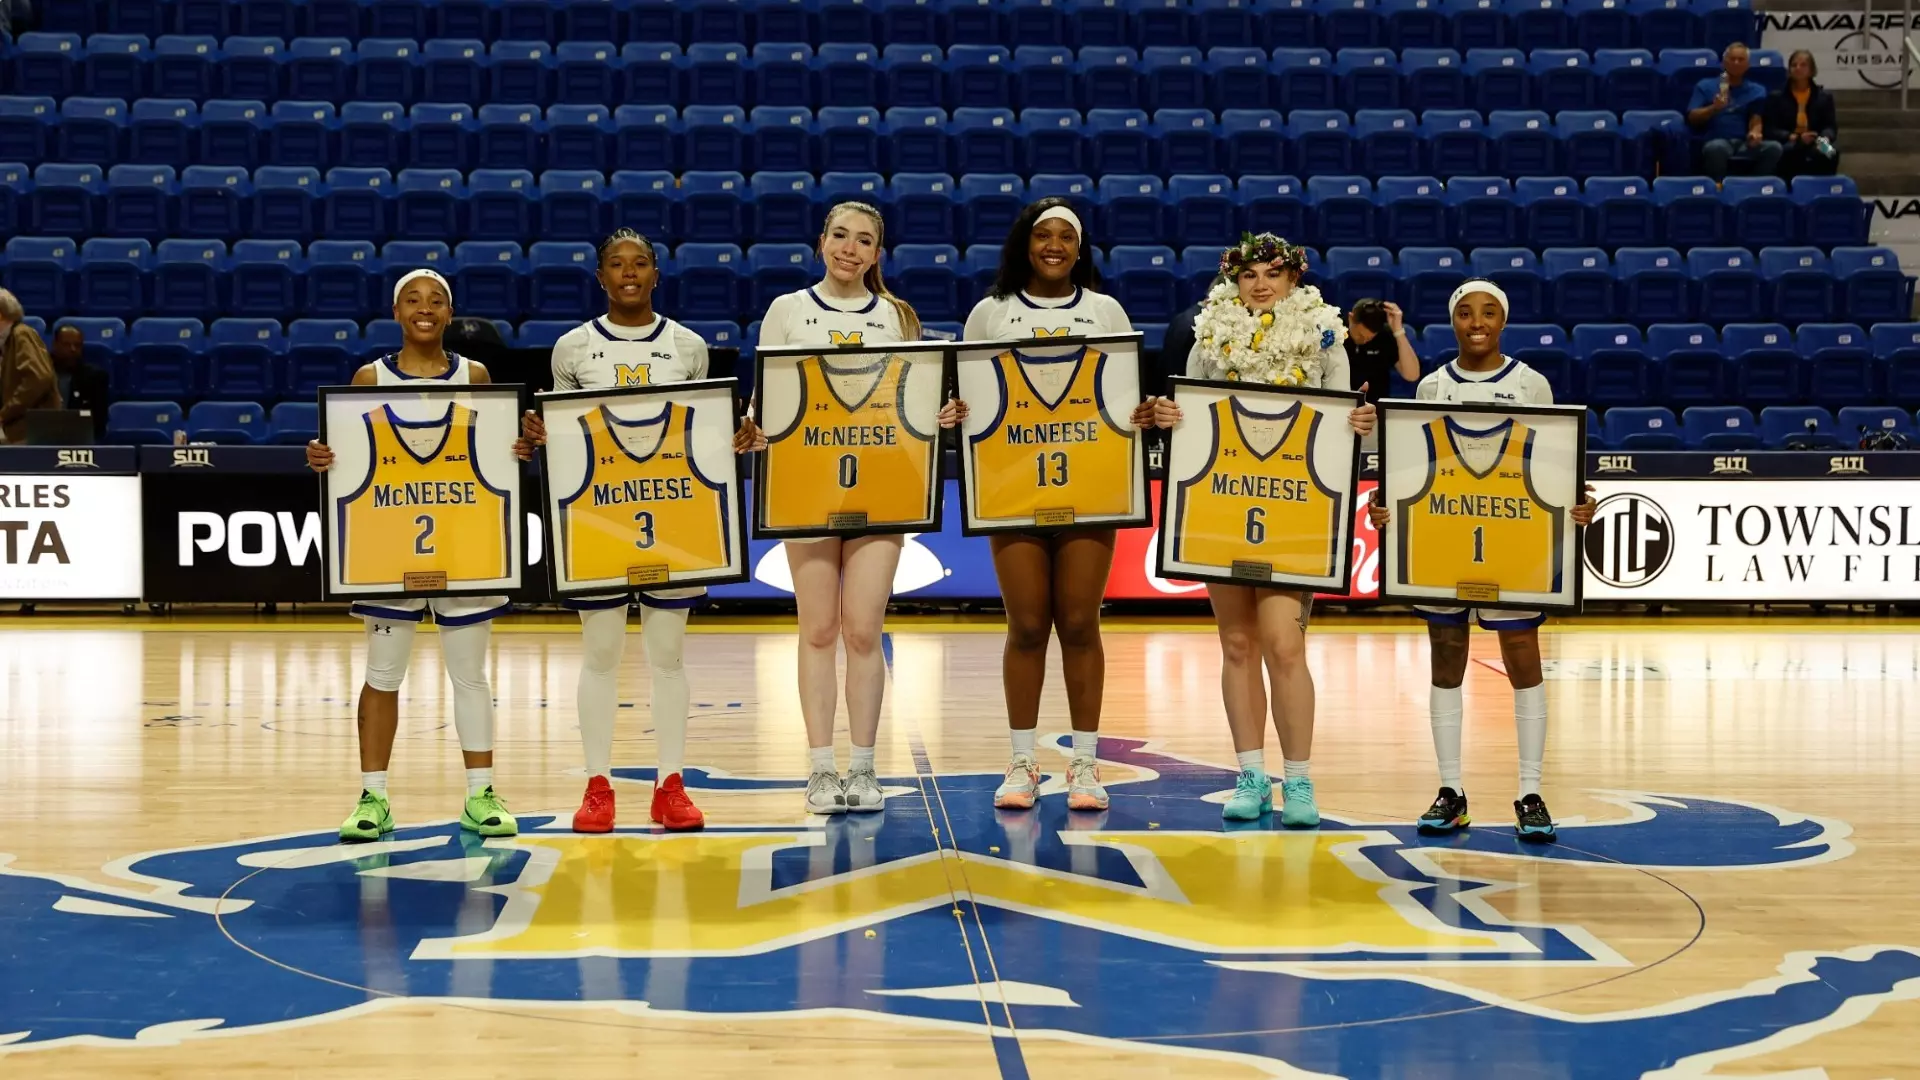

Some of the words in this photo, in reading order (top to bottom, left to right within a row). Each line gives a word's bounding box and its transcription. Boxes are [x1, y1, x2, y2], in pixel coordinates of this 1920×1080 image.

[614, 363, 652, 388] M
[838, 453, 859, 489] 0
[1035, 450, 1070, 488] 13
[0, 520, 71, 565] TA
[178, 511, 322, 567] POW
[413, 513, 436, 557] 2
[633, 510, 656, 550] 3
[1244, 505, 1267, 545] 6
[1471, 525, 1486, 564] 1
[1706, 554, 1815, 582] LAW
[1843, 554, 1920, 582] FI
